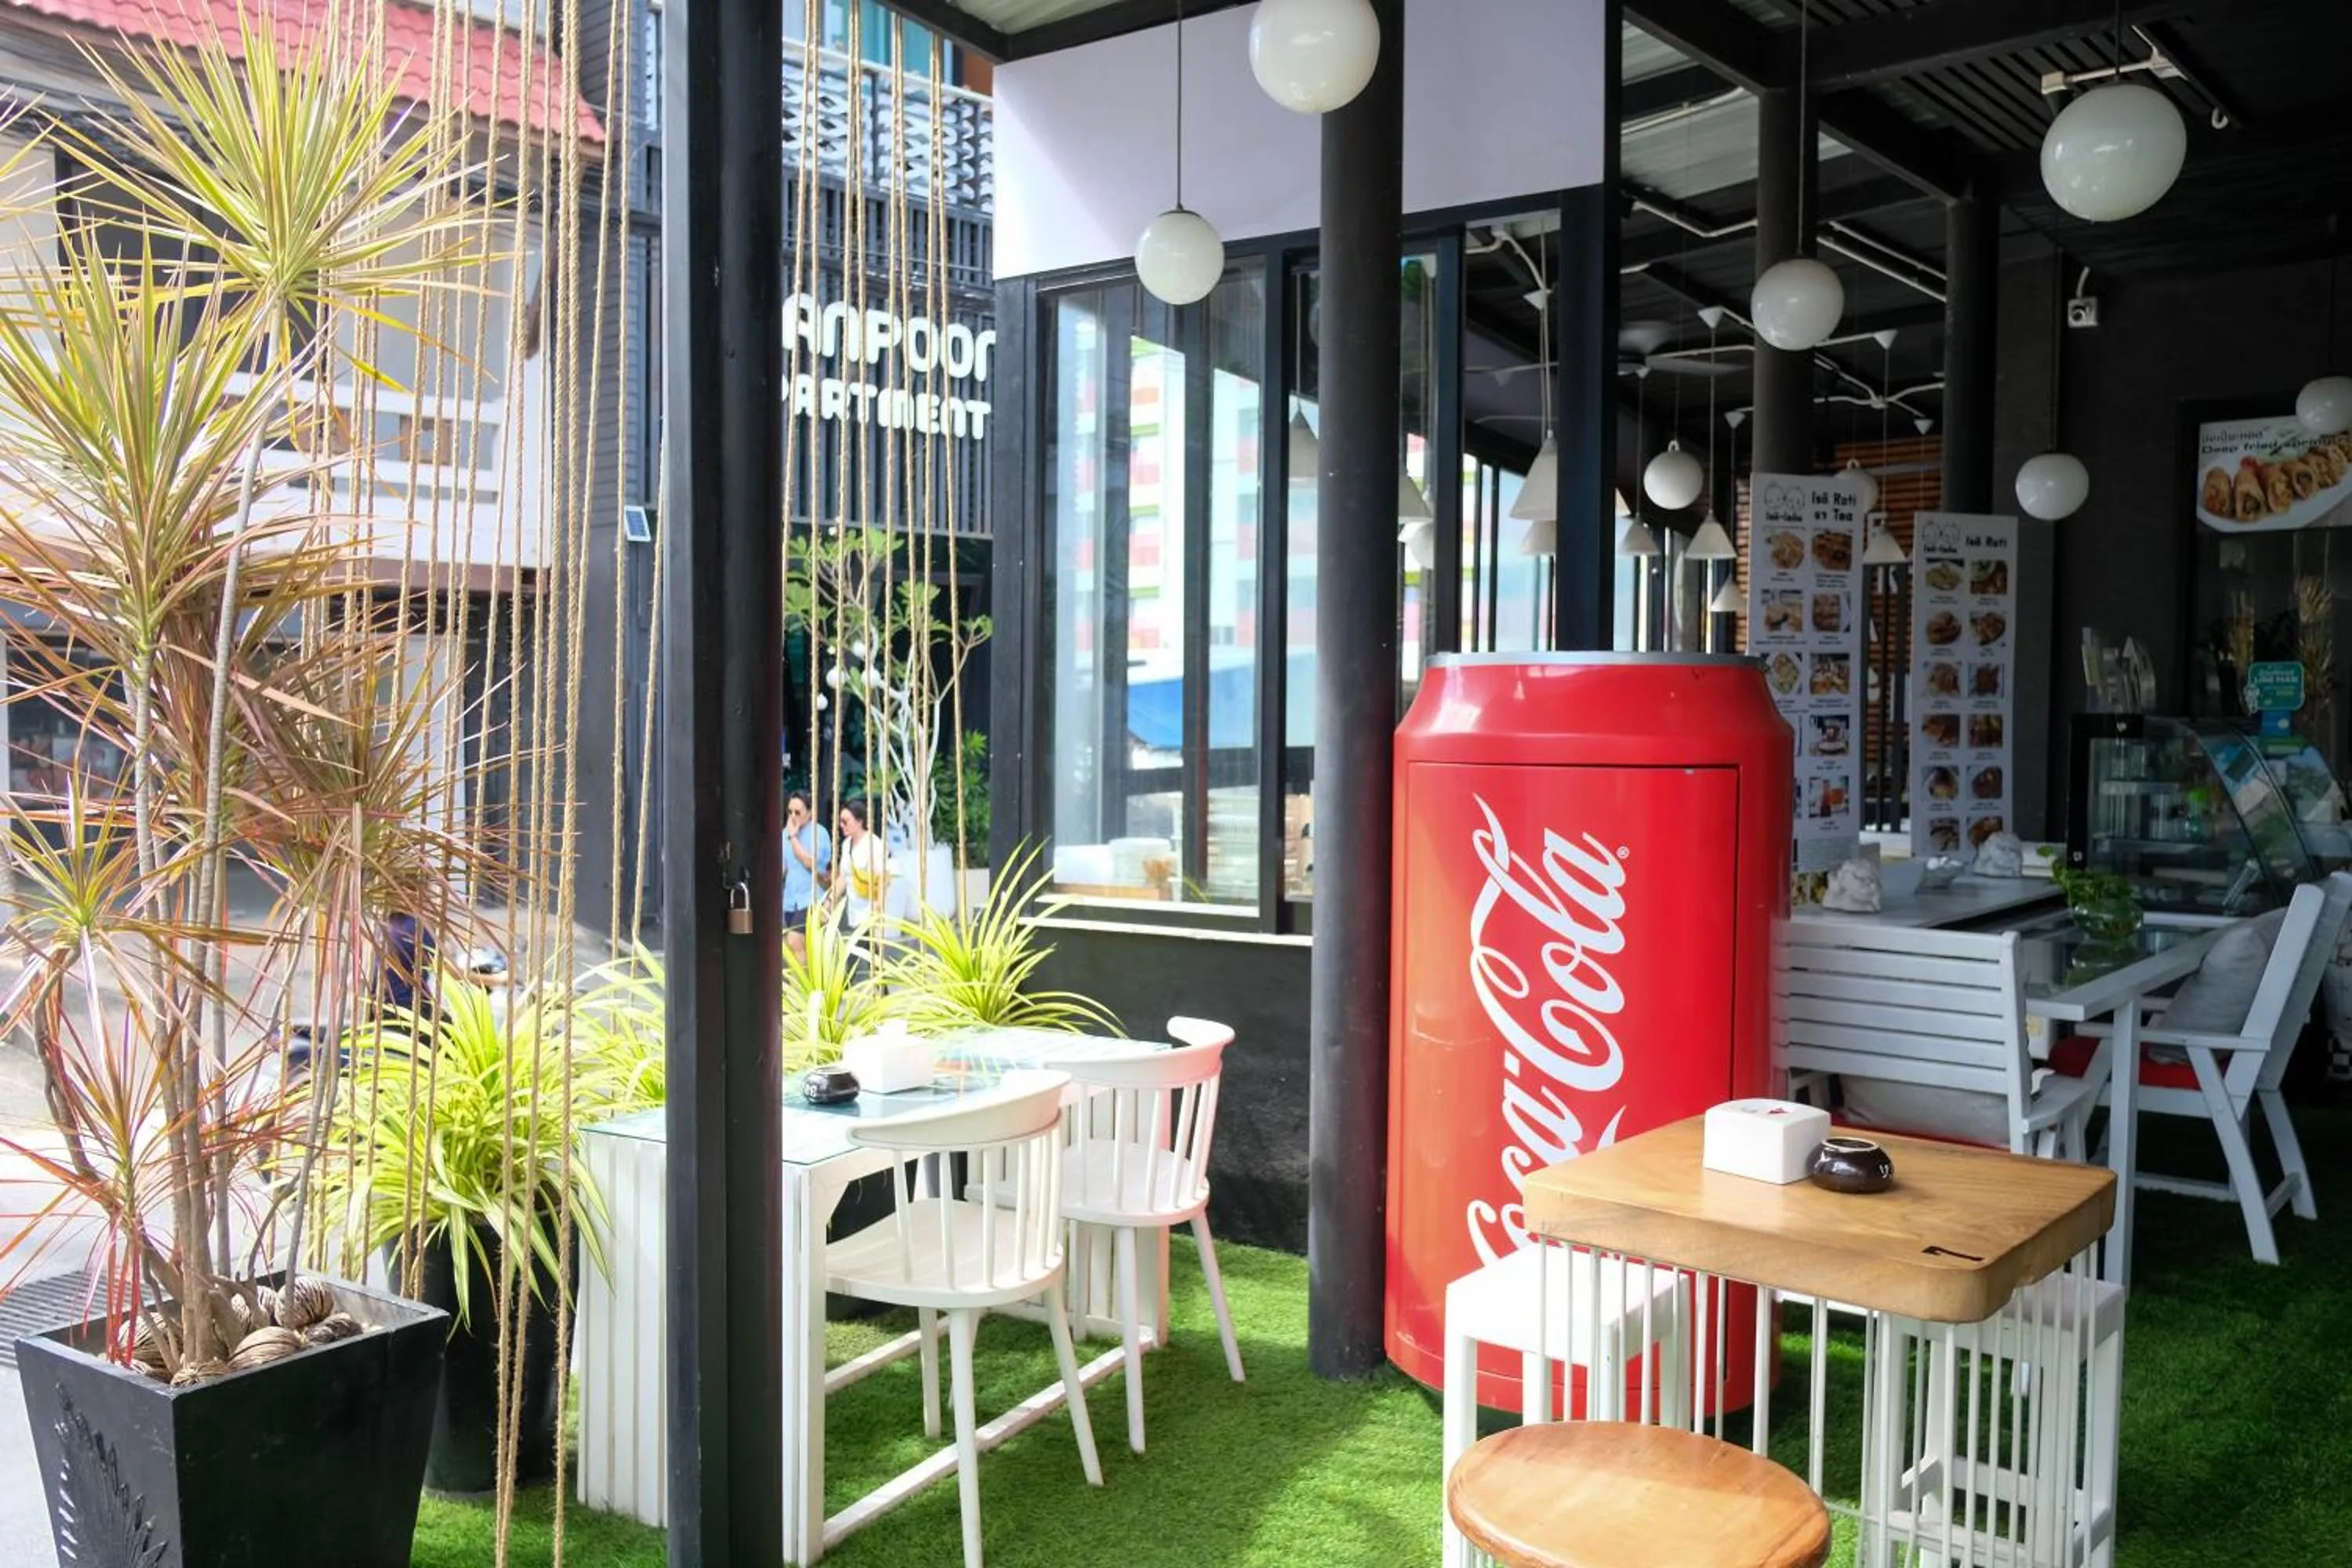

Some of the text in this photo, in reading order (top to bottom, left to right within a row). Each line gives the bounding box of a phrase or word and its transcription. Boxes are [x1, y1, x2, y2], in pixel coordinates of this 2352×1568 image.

[782, 373, 991, 440] ARTMENT
[2201, 444, 2238, 454] Deep
[2244, 440, 2278, 452] fried
